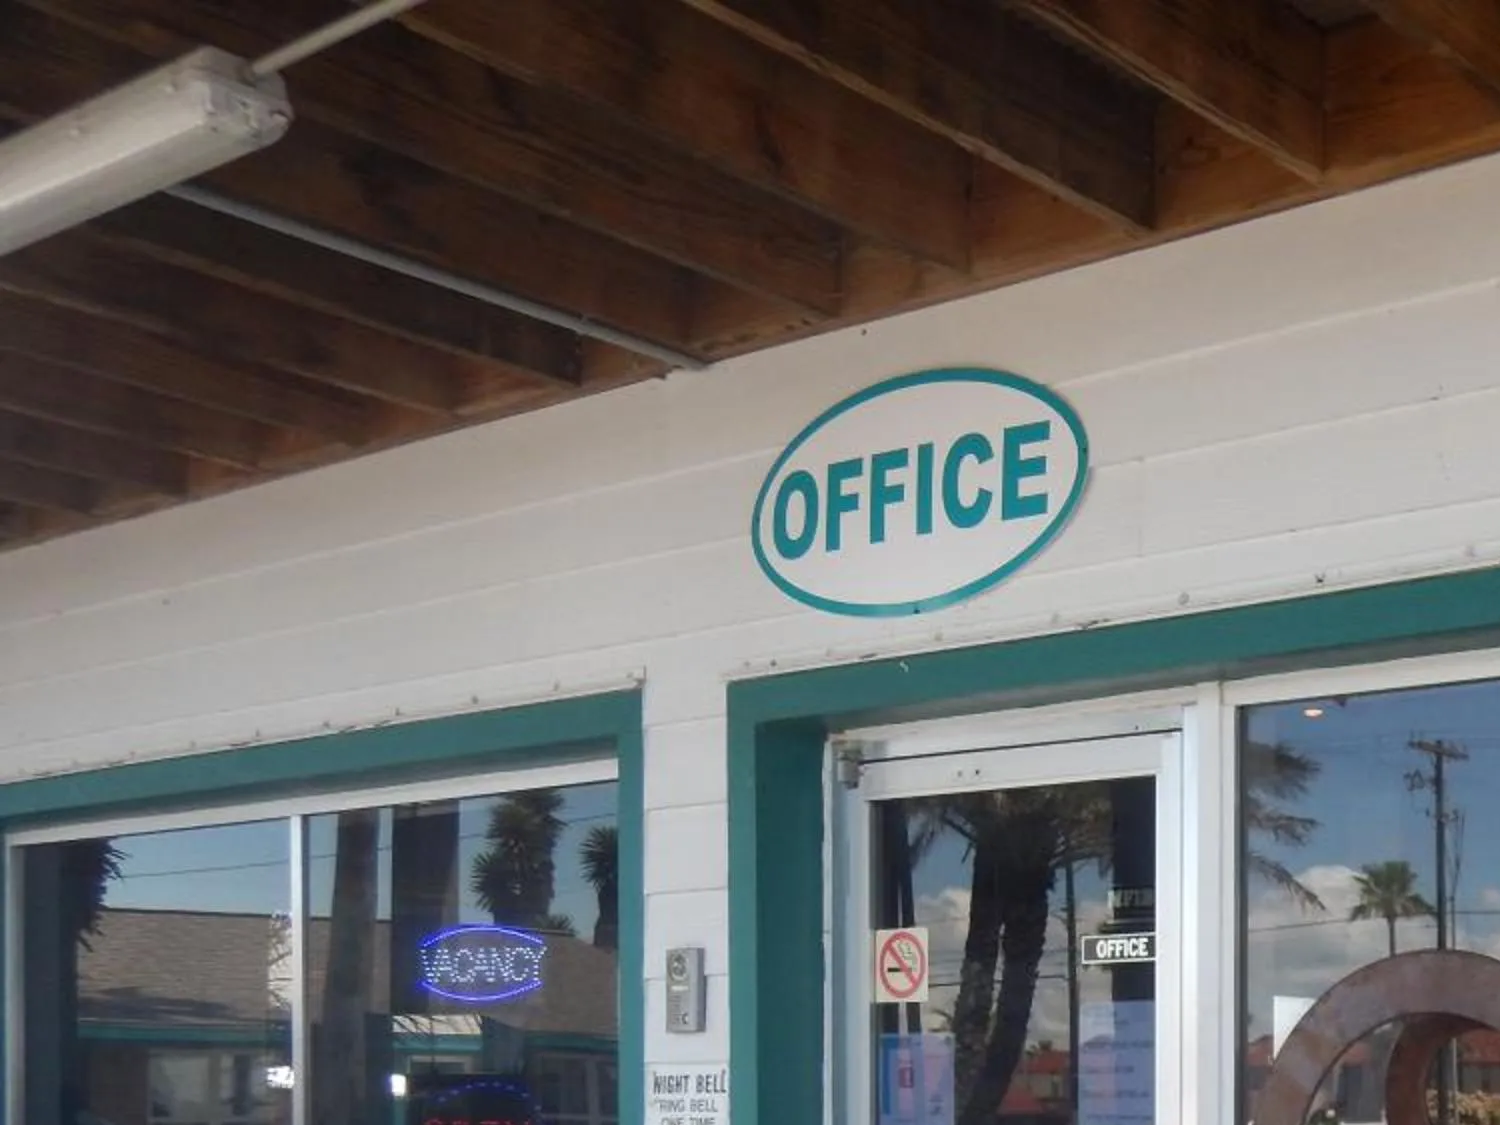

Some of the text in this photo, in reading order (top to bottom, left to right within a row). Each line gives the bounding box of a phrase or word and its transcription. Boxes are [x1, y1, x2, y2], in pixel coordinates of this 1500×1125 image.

[773, 420, 1051, 560] OFFICE
[1095, 937, 1149, 958] OFFICE
[420, 947, 548, 983] VACANCY
[653, 1070, 726, 1094] NIGHT BELL
[659, 1099, 718, 1113] RING BELL
